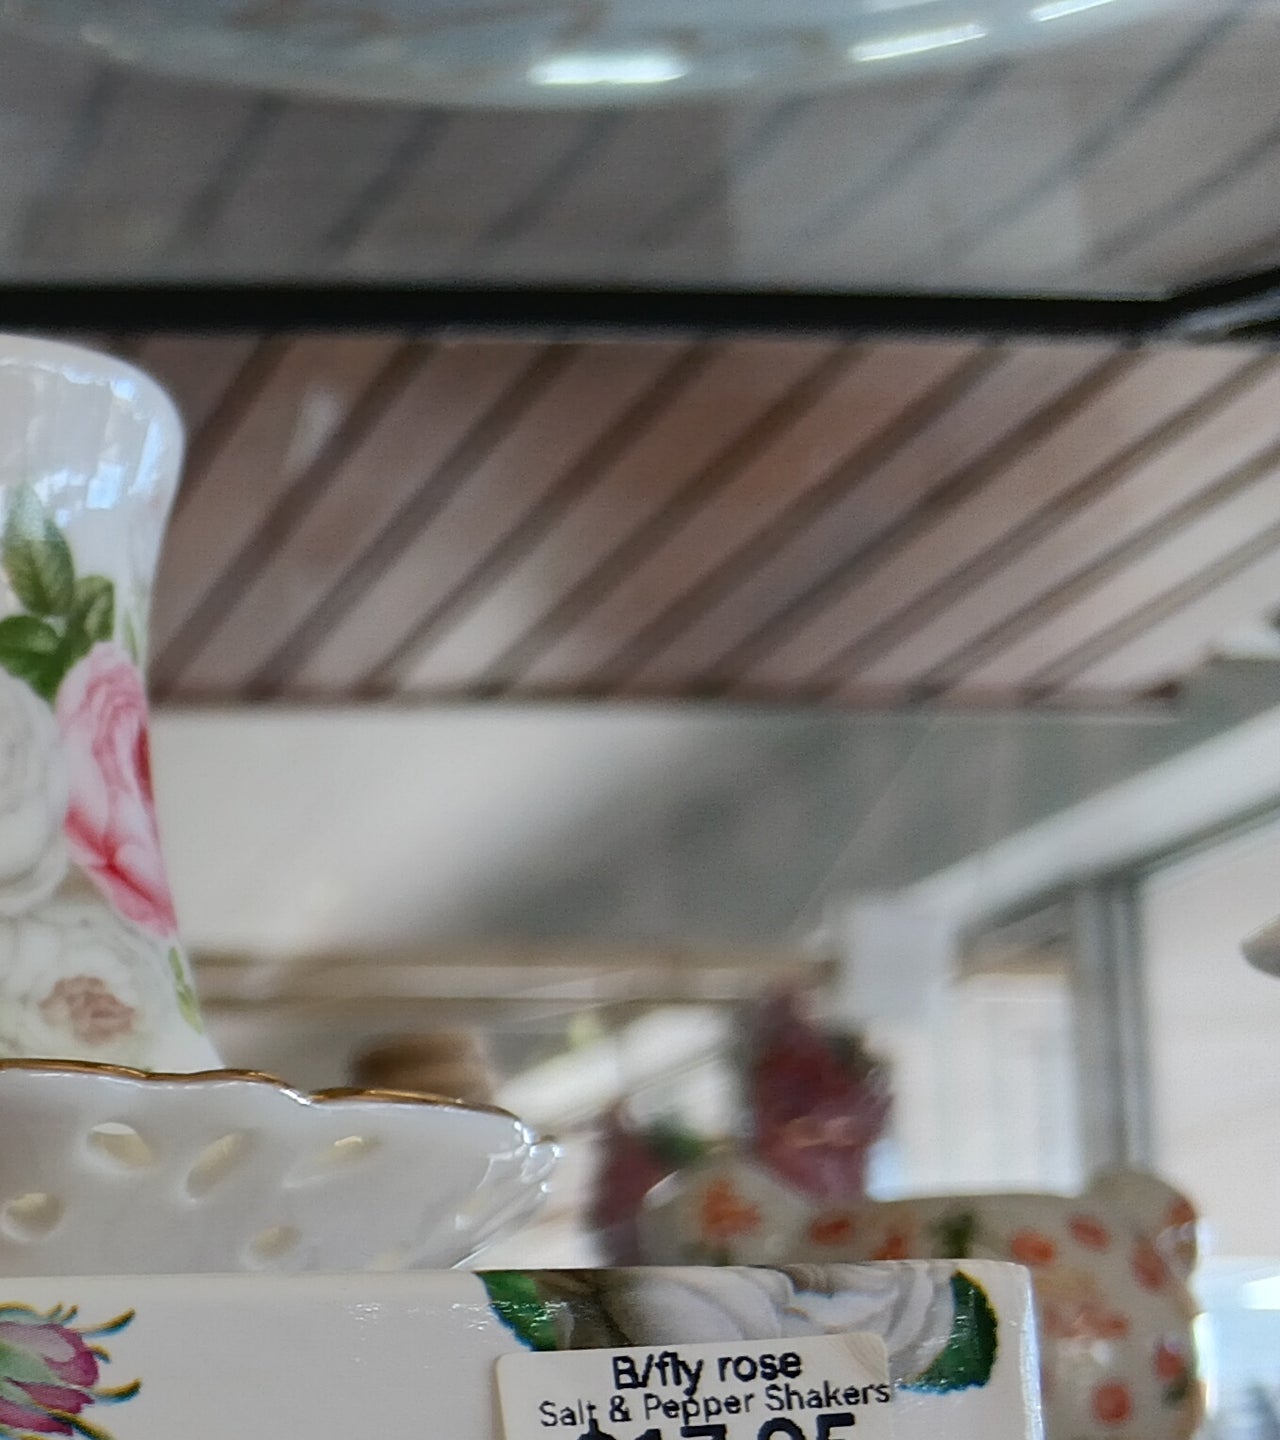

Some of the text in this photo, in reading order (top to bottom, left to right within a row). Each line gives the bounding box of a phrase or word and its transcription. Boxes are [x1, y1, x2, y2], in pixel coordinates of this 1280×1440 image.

[611, 1351, 802, 1396] B/fly rose
[539, 1380, 891, 1426] Salt & Pepper Shakers
